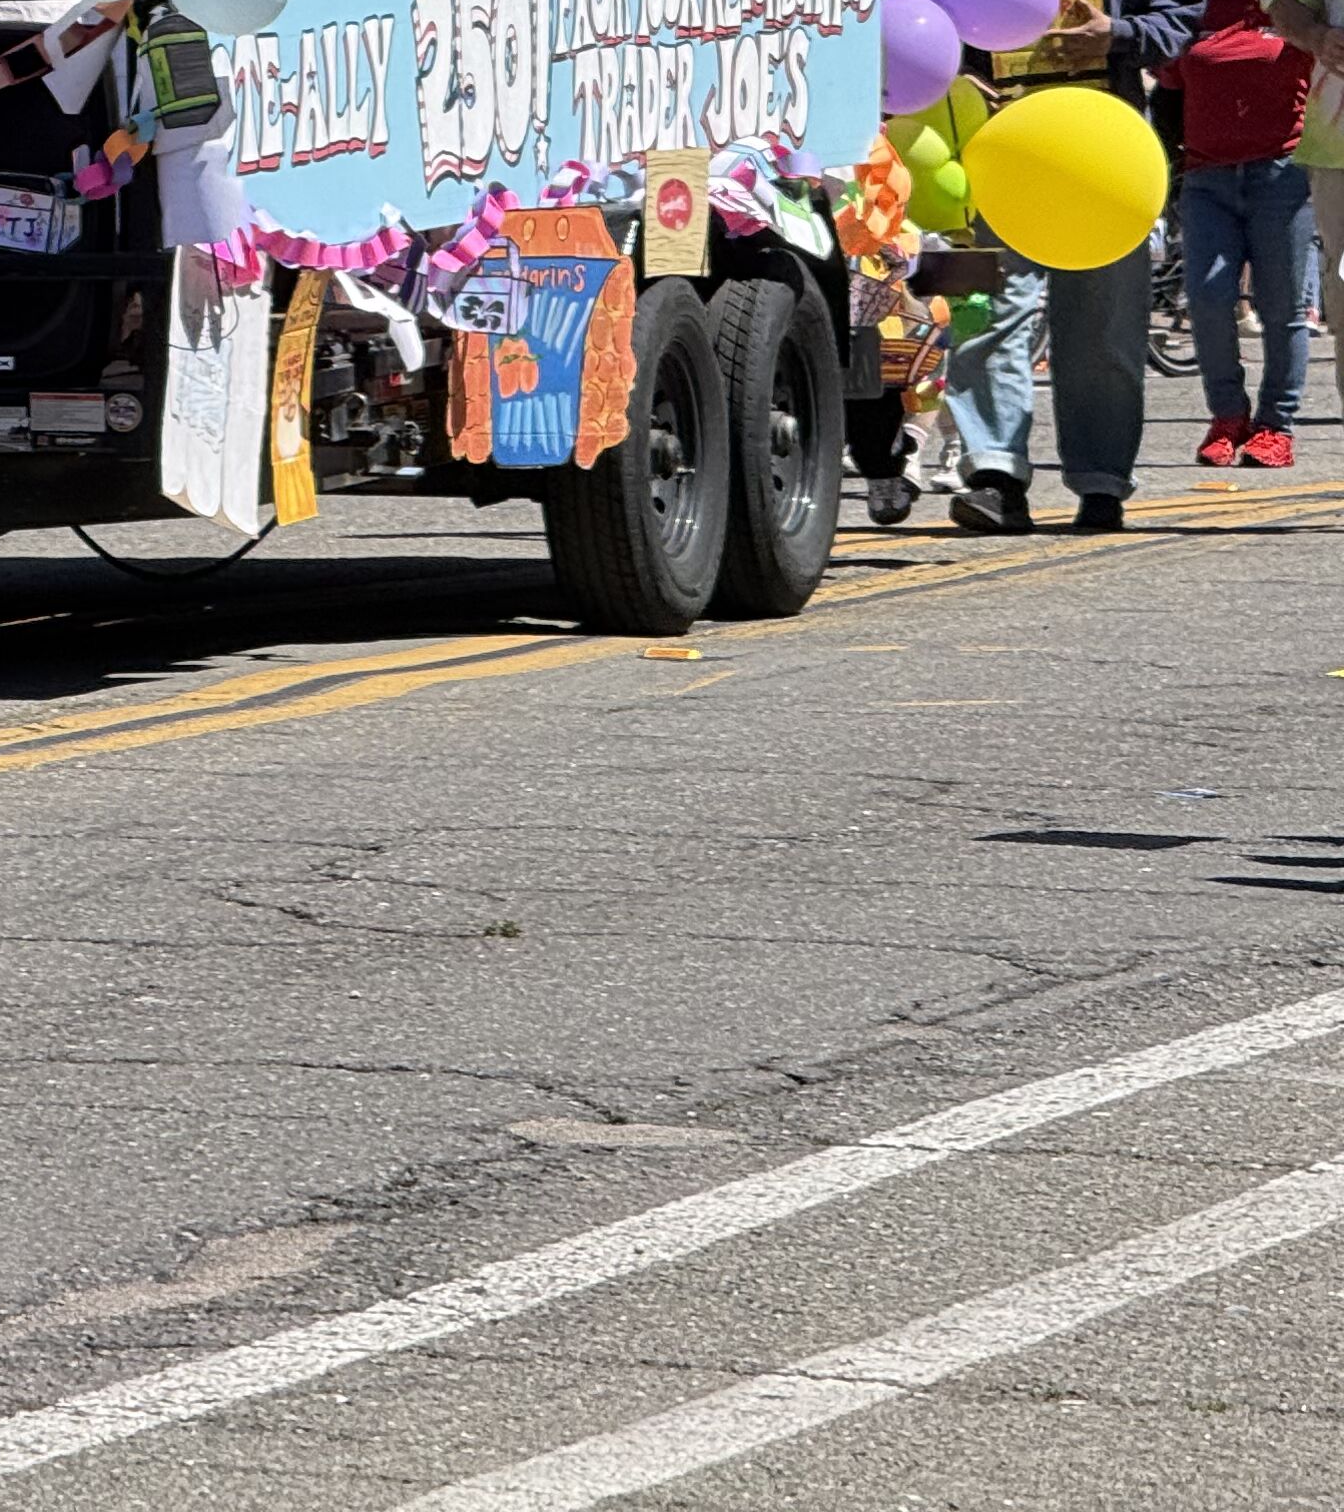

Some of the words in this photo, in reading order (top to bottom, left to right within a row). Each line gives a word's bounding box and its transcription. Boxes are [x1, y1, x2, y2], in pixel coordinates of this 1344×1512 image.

[211, 14, 395, 176] TE-ALLY
[573, 40, 698, 166] TRADER
[700, 26, 810, 151] JOE'S
